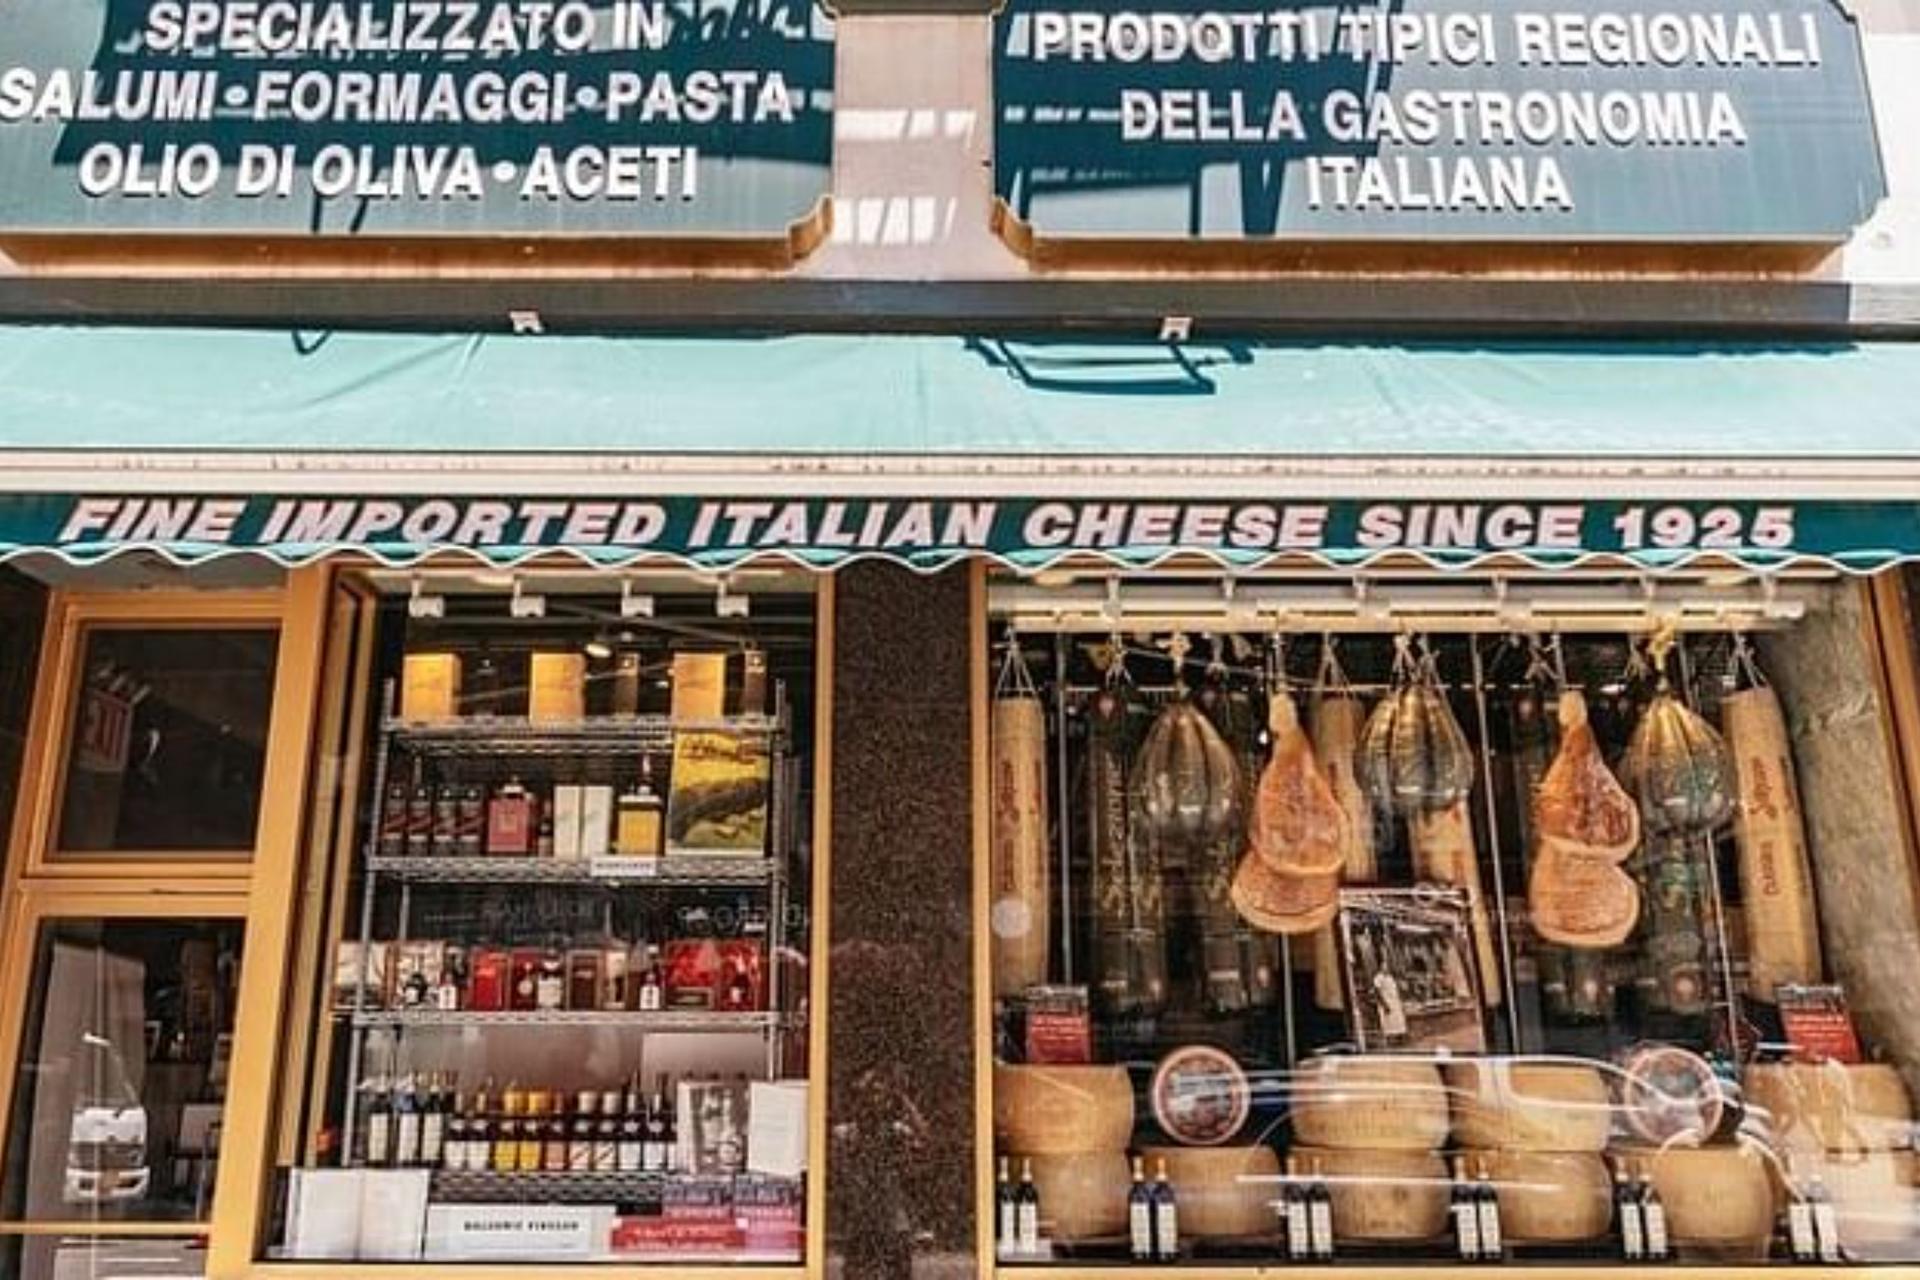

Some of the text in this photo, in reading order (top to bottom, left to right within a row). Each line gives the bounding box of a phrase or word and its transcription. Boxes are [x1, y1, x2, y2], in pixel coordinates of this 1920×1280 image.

[145, 1, 665, 52] SPECIALIZZATO IN
[1034, 12, 1820, 67] PRODOTTI TIPICI REGIONALI
[254, 71, 566, 122] FORMAGGI
[607, 71, 795, 122] PASTA
[1121, 90, 1746, 146] DELLA GASTRONOMIA
[79, 144, 698, 199] OLIO DI OLIVA ACETI
[1307, 156, 1572, 210] ITALIANA
[59, 499, 1797, 550] FINE IMPORTED ITALIAN CHEESE SINCE 1925
